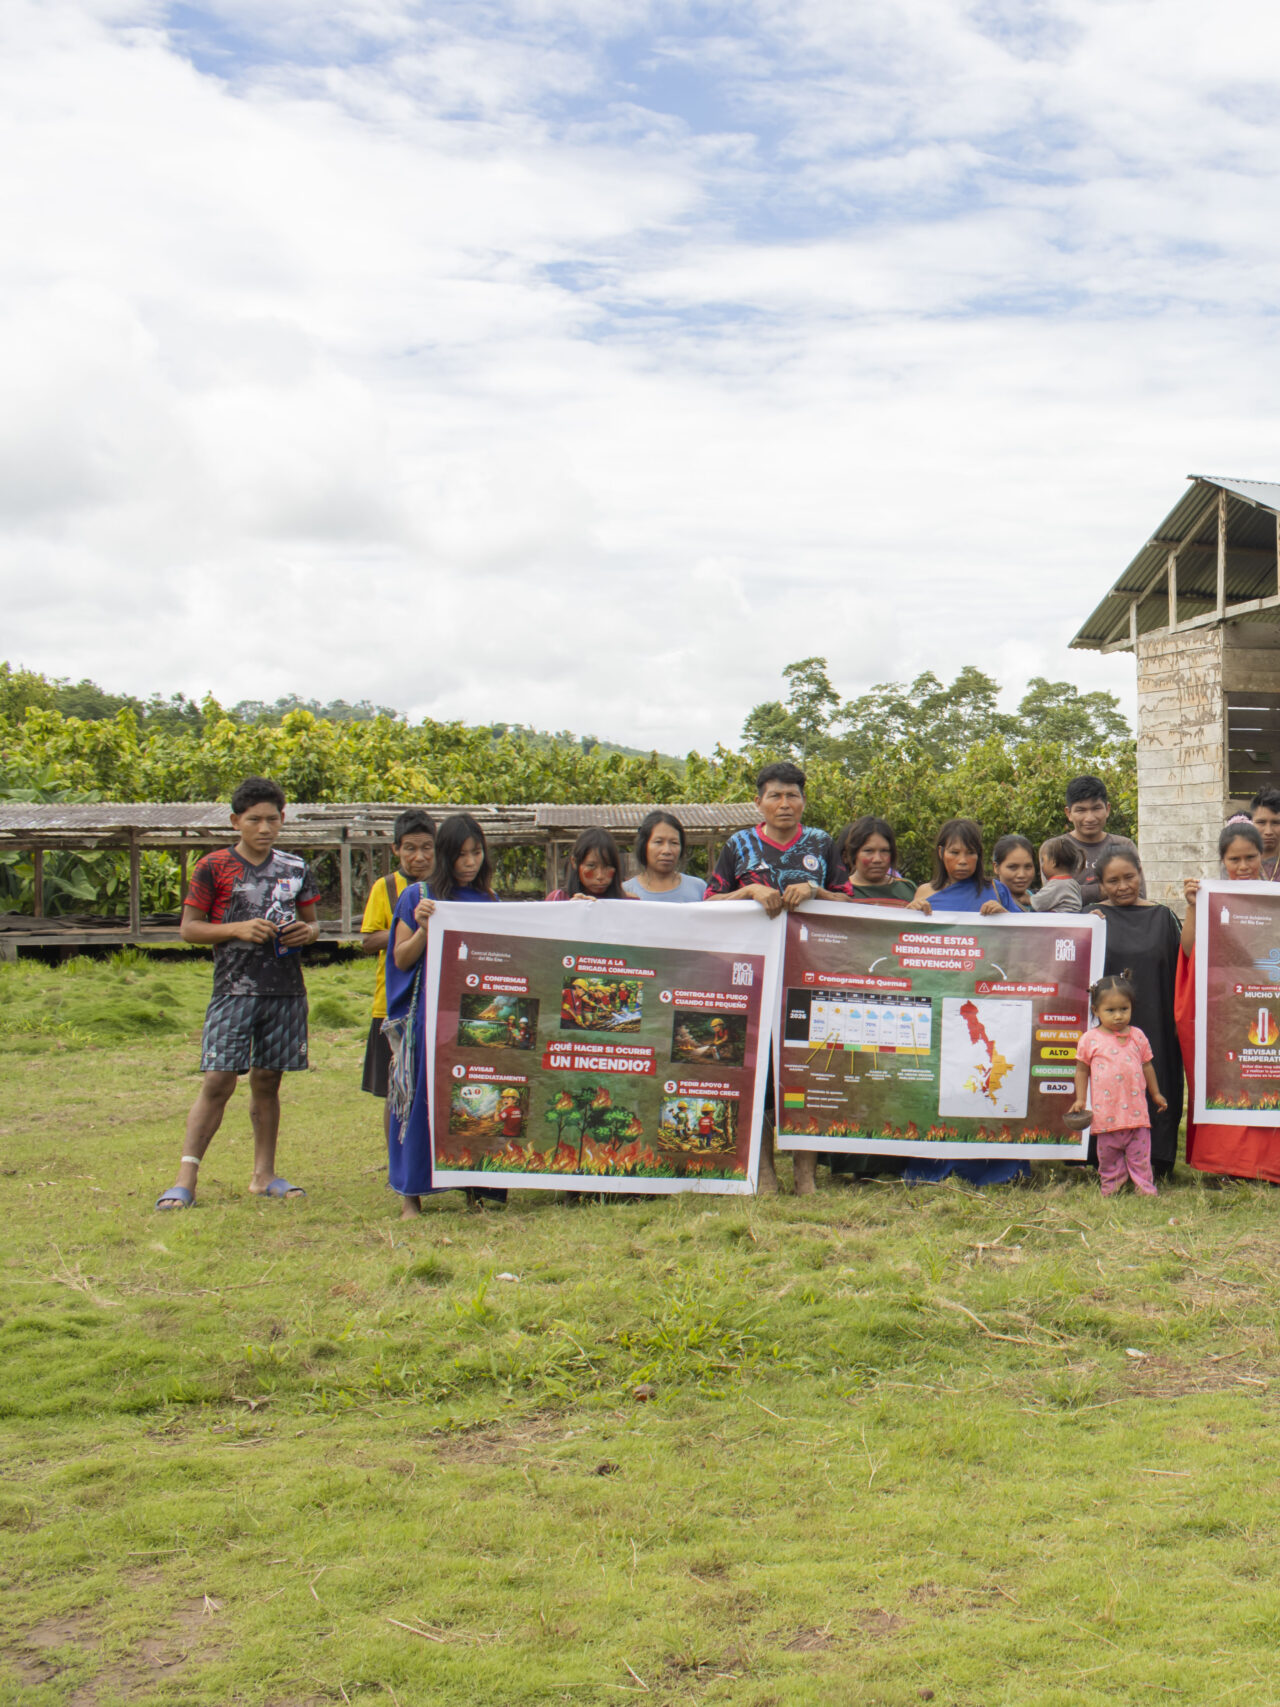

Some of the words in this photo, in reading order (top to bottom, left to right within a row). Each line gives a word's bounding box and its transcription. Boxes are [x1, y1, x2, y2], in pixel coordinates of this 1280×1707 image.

[902, 933, 942, 944] CONOCE
[943, 936, 975, 946] ESTAS
[1055, 938, 1075, 949] COOL
[895, 945, 967, 957] HERRAMIENTAS
[968, 949, 981, 957] DE
[565, 957, 572, 966] 3
[578, 957, 607, 965] ACTIVAR
[903, 958, 962, 969] PREVENCIÓN
[577, 964, 607, 973] BRIGADA
[608, 966, 655, 976] COMUNITARIA
[733, 962, 754, 973] COOL
[469, 975, 477, 986] 2
[484, 975, 527, 984] CONFIRMAR
[818, 974, 864, 985] Cronograma
[876, 979, 907, 988] Quemas
[492, 984, 528, 993] INCENDIO
[991, 984, 1016, 992] Alerta
[1016, 985, 1026, 993] de
[1027, 985, 1055, 994] Peligro
[1235, 985, 1243, 993] 2
[674, 990, 716, 999] CONTROLAR
[726, 993, 749, 1001] FUEGO
[1244, 991, 1273, 999] MUCHO
[674, 998, 703, 1006] CUANDO
[715, 1000, 747, 1009] PEQUEÑO
[549, 1042, 573, 1052] ¿QUÉ
[573, 1044, 604, 1053] HACER
[615, 1047, 652, 1056] OCURRE
[1242, 1048, 1277, 1056] REVISAR
[1229, 1052, 1234, 1060] 1
[550, 1055, 571, 1068] UN
[574, 1056, 652, 1073] INCENDIO?
[456, 1067, 461, 1076] 1
[468, 1073, 527, 1082] INMEDIATAMENTE
[667, 1083, 674, 1091] 5
[688, 1088, 719, 1096] INCENDIO
